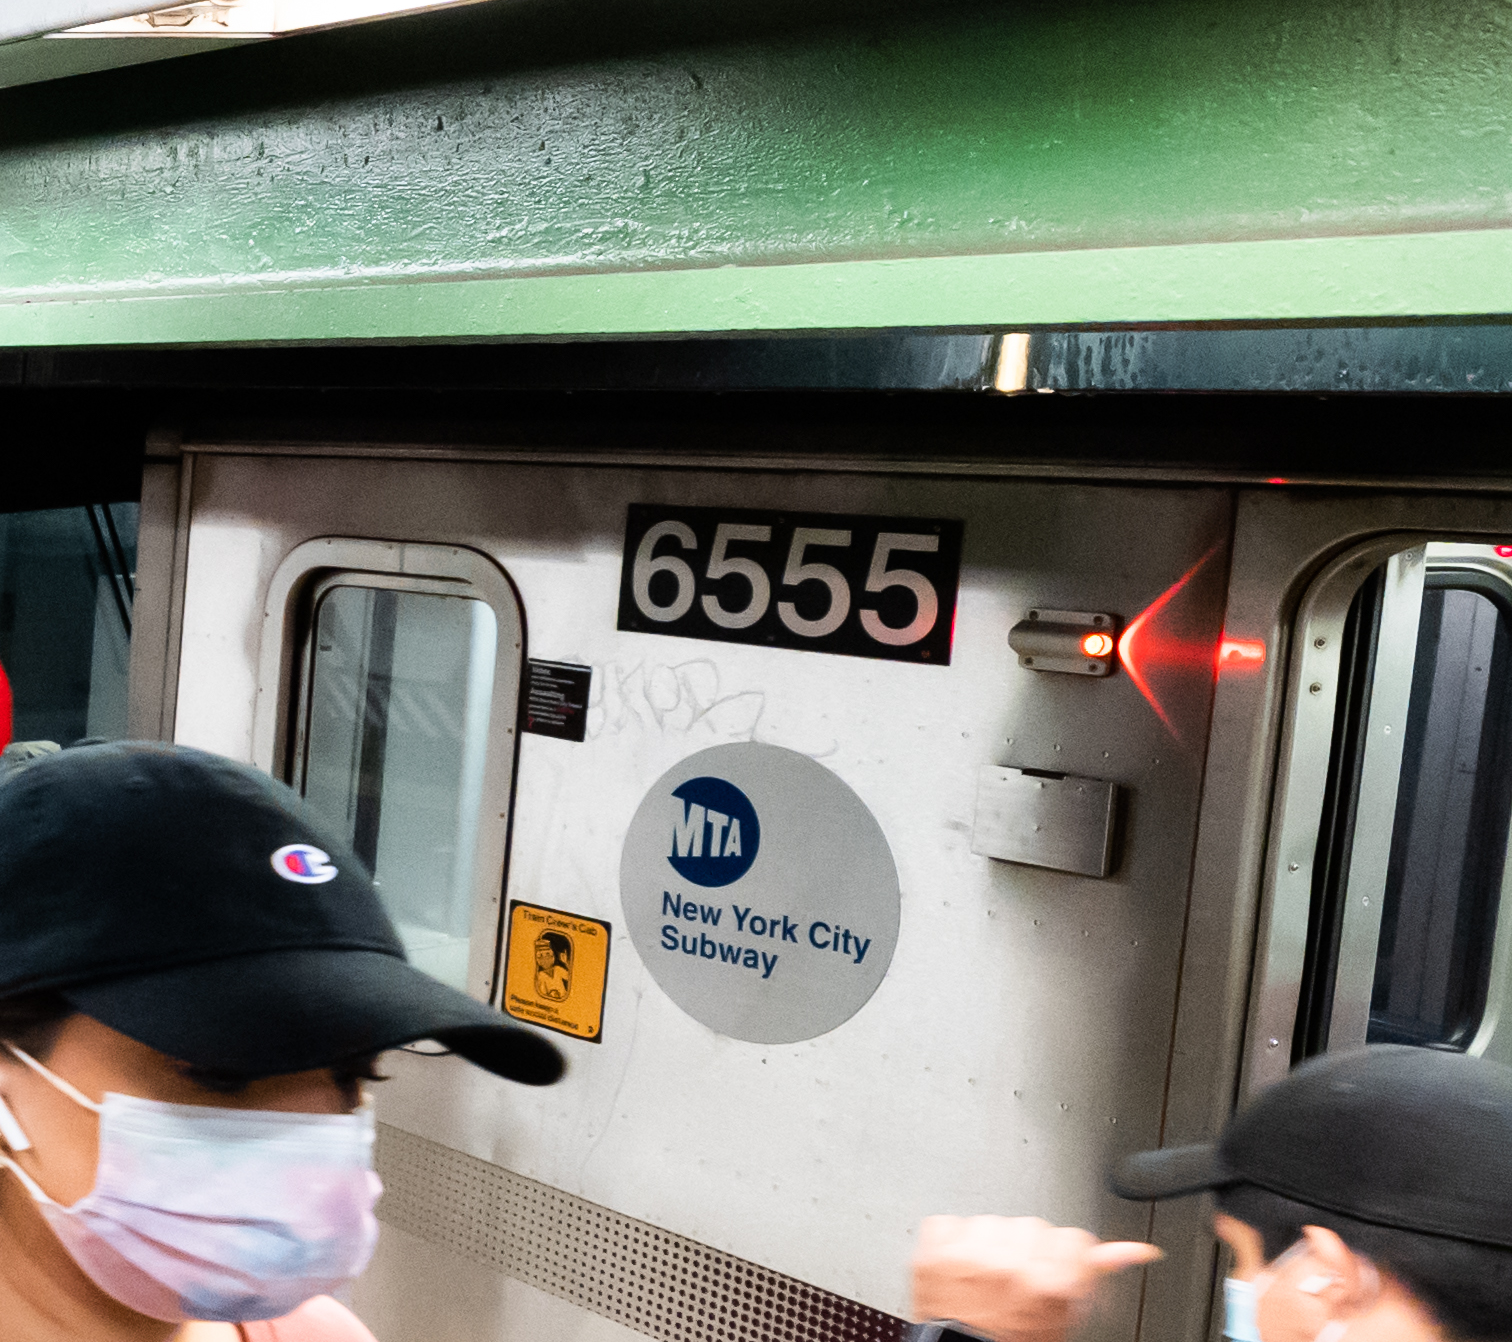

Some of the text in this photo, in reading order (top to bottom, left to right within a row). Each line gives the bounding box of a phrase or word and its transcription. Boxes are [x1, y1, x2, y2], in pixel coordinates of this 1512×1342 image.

[630, 519, 942, 647] 6555
[667, 797, 743, 858] MTA
[523, 909, 545, 924] Train
[579, 923, 598, 937] Cab
[661, 891, 872, 964] New York City
[661, 924, 780, 979] Subway
